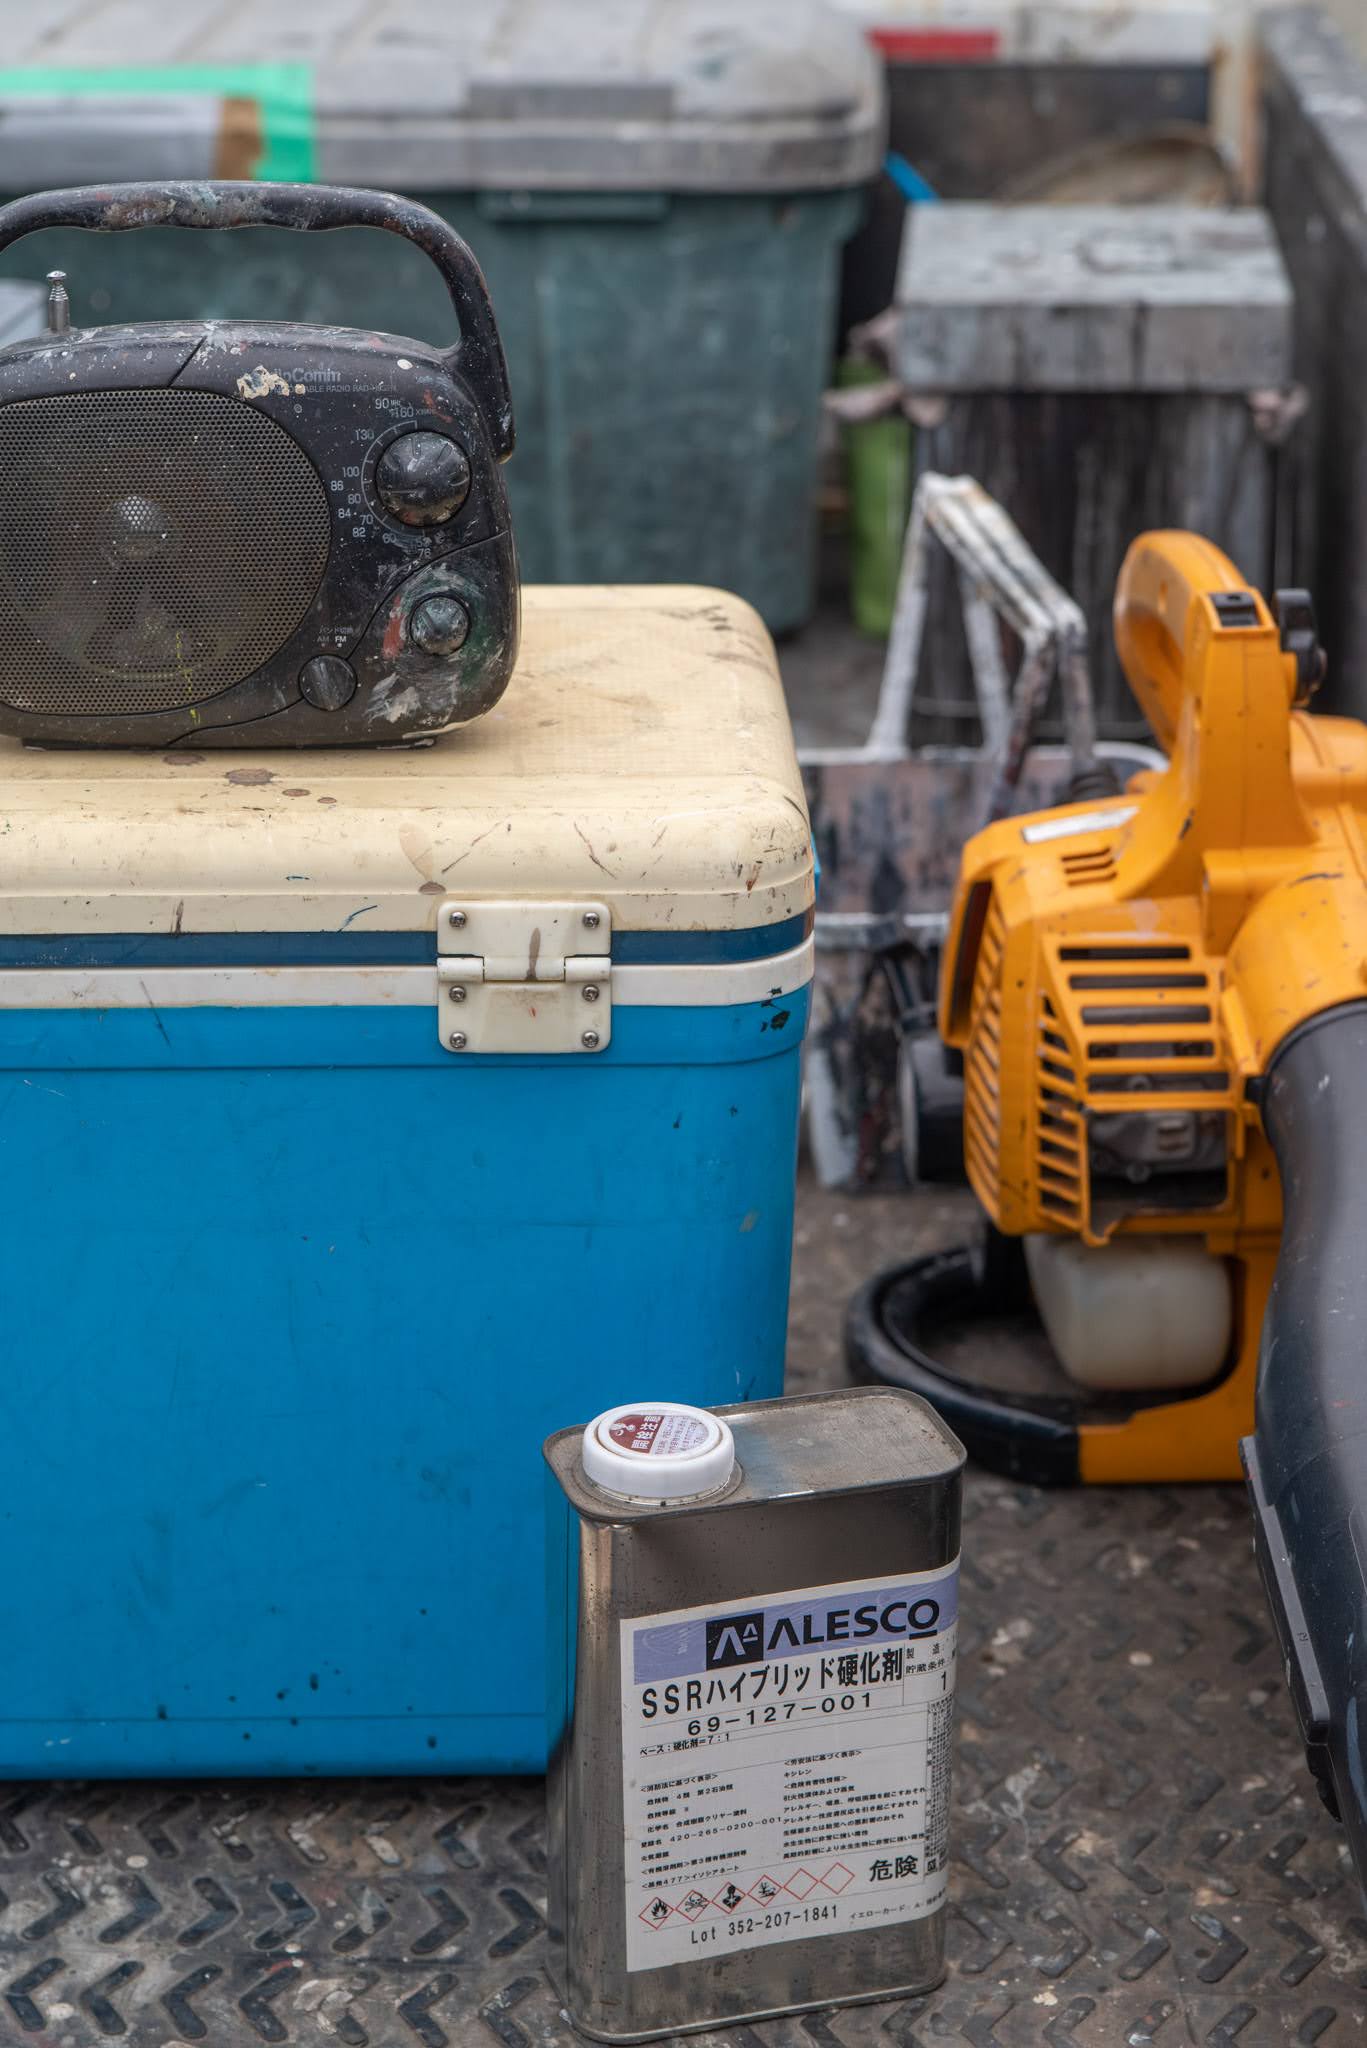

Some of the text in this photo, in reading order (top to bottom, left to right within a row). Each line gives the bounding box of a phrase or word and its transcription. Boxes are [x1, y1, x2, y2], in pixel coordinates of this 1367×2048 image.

[375, 398, 389, 409] 90
[355, 429, 375, 441] 130
[342, 466, 360, 477] 100
[348, 494, 361, 505] 80
[338, 508, 351, 518] 84
[360, 514, 374, 525] 70
[352, 527, 366, 538] 82
[418, 548, 431, 559] 76
[335, 635, 347, 643] FM
[767, 1598, 940, 1650] ALESCO
[641, 1647, 904, 1718] SSRハイブリッド硬化剤
[687, 1691, 871, 1736] 69-127-001
[869, 1854, 919, 1882] 危険
[691, 1905, 838, 1945] Lot 352-207-1841
